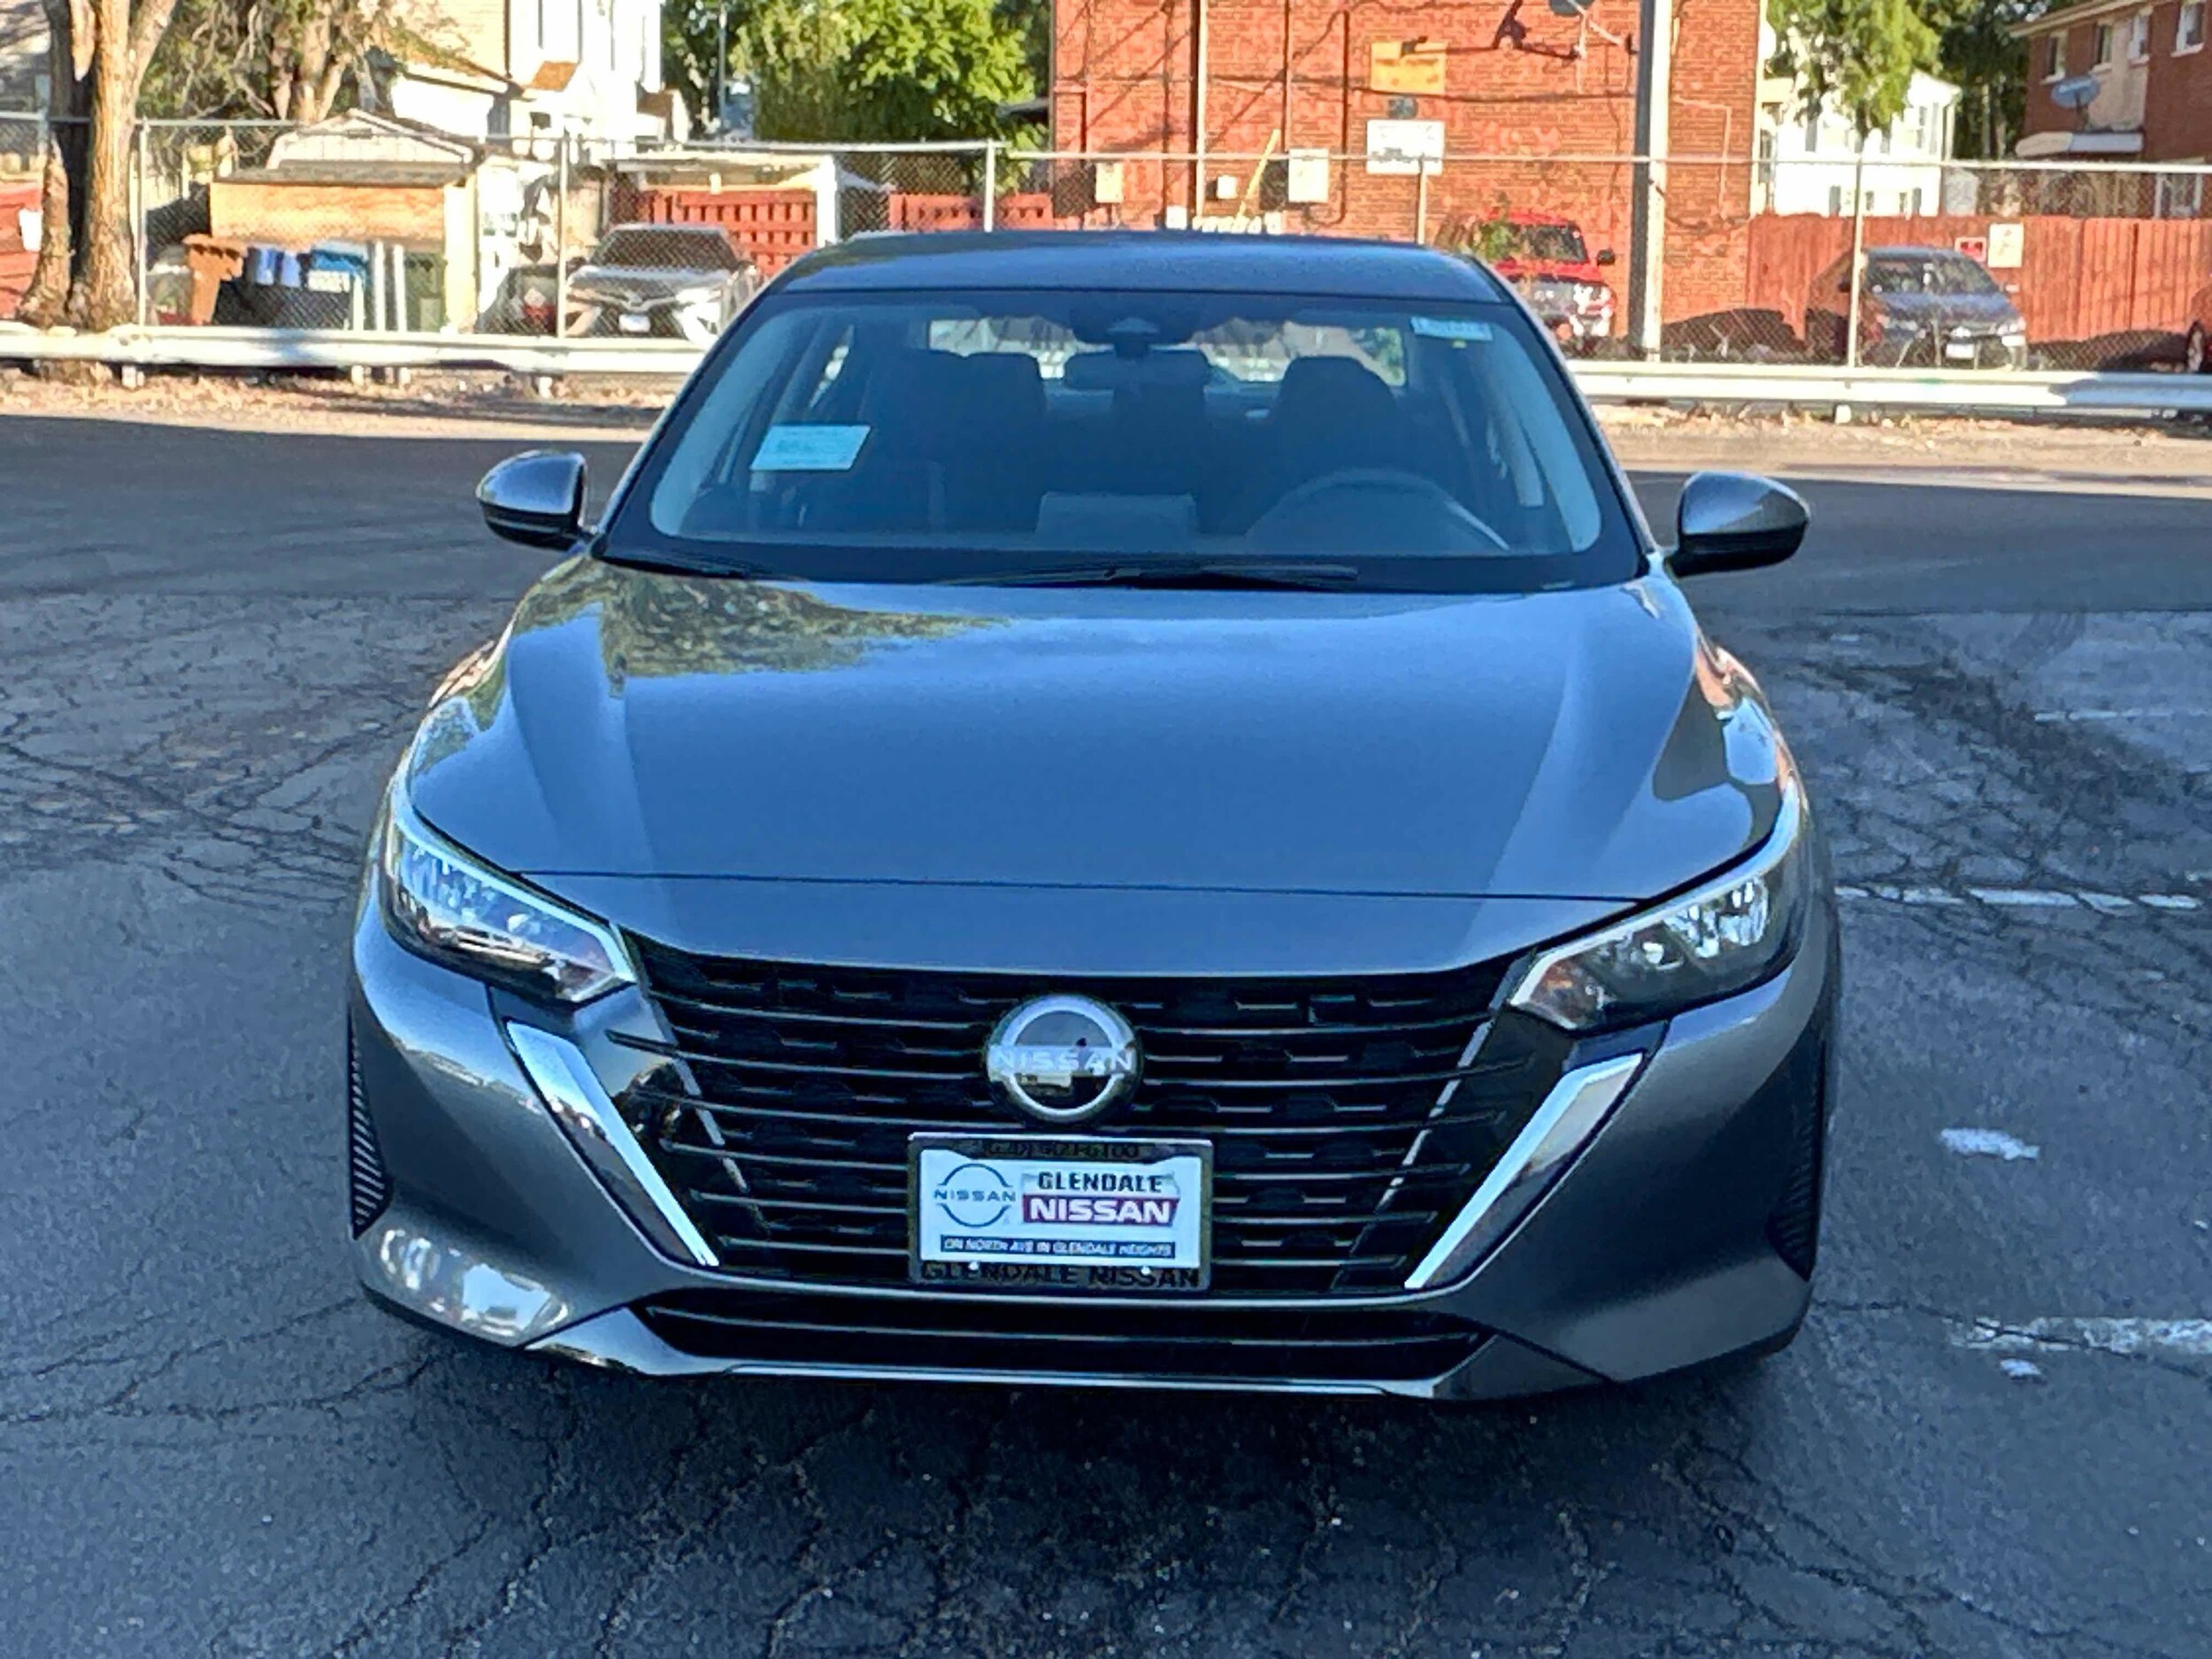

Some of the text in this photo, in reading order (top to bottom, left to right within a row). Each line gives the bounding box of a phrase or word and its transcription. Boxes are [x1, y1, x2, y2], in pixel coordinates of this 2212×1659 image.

[993, 1049, 1133, 1073] NISSAN
[1037, 1171, 1162, 1194] GLENDALE
[934, 1189, 1017, 1202] NISSAN
[1030, 1197, 1171, 1224] NISSAN
[920, 1262, 1200, 1289] GLENDALE NISSAN
